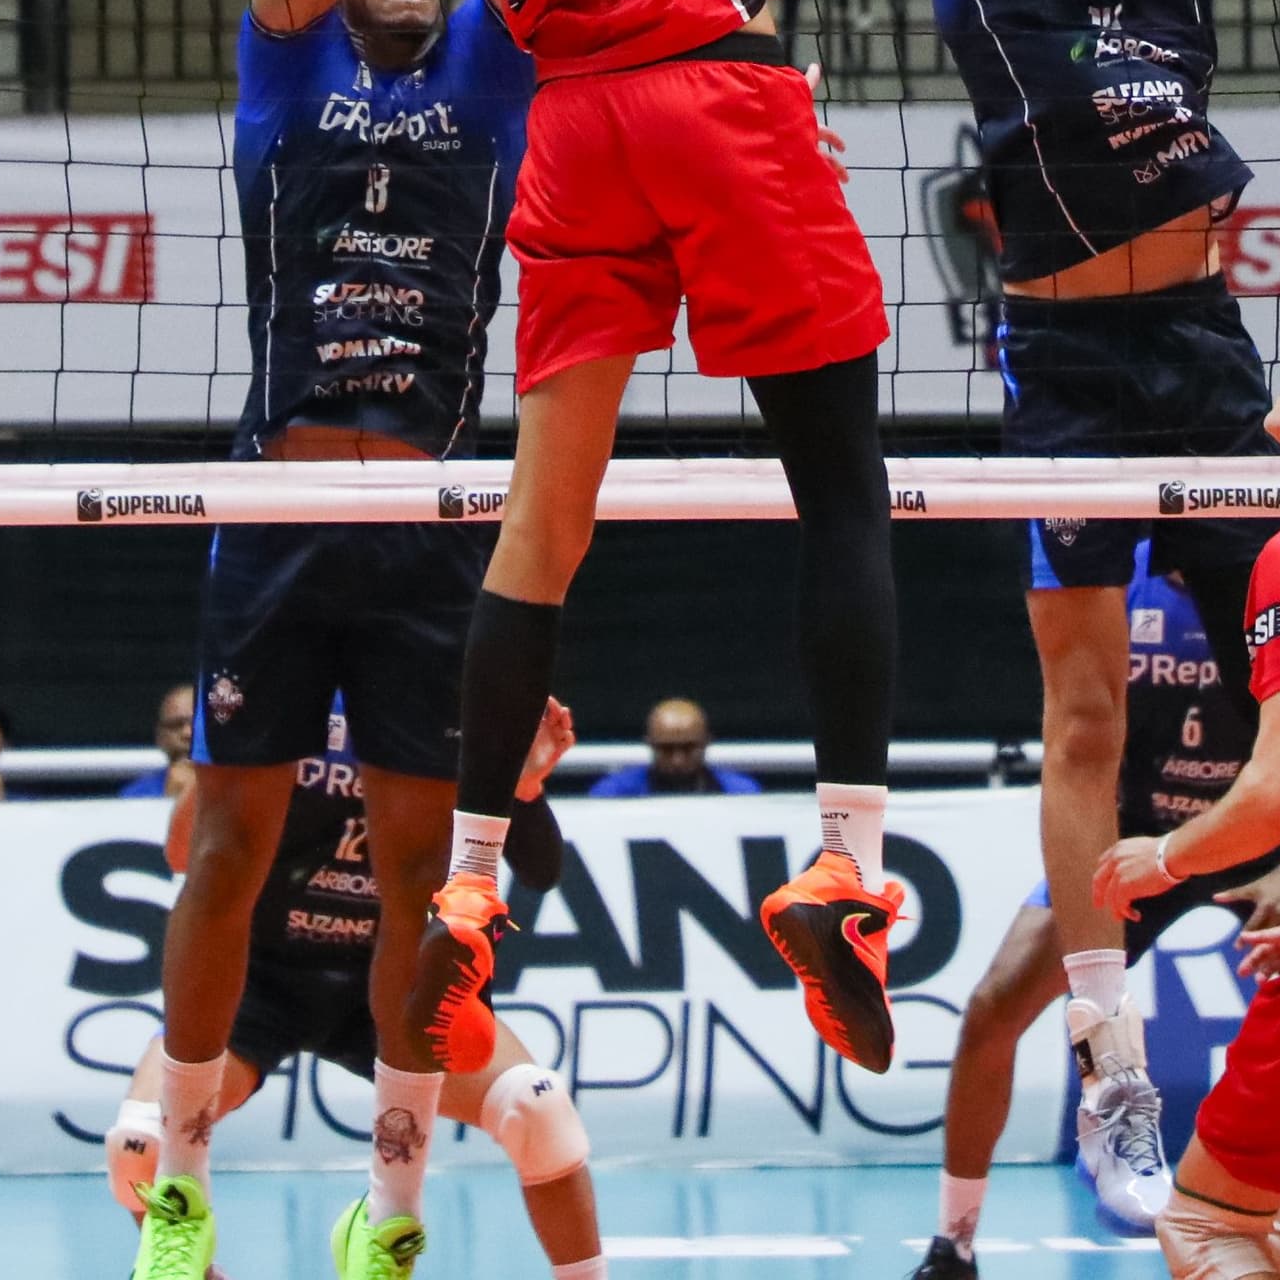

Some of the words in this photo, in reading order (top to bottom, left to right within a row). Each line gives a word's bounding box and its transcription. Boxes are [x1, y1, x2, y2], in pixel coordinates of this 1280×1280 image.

[107, 496, 205, 518] SUPERLIGA
[1182, 706, 1203, 749] 6
[60, 831, 962, 997] SANO
